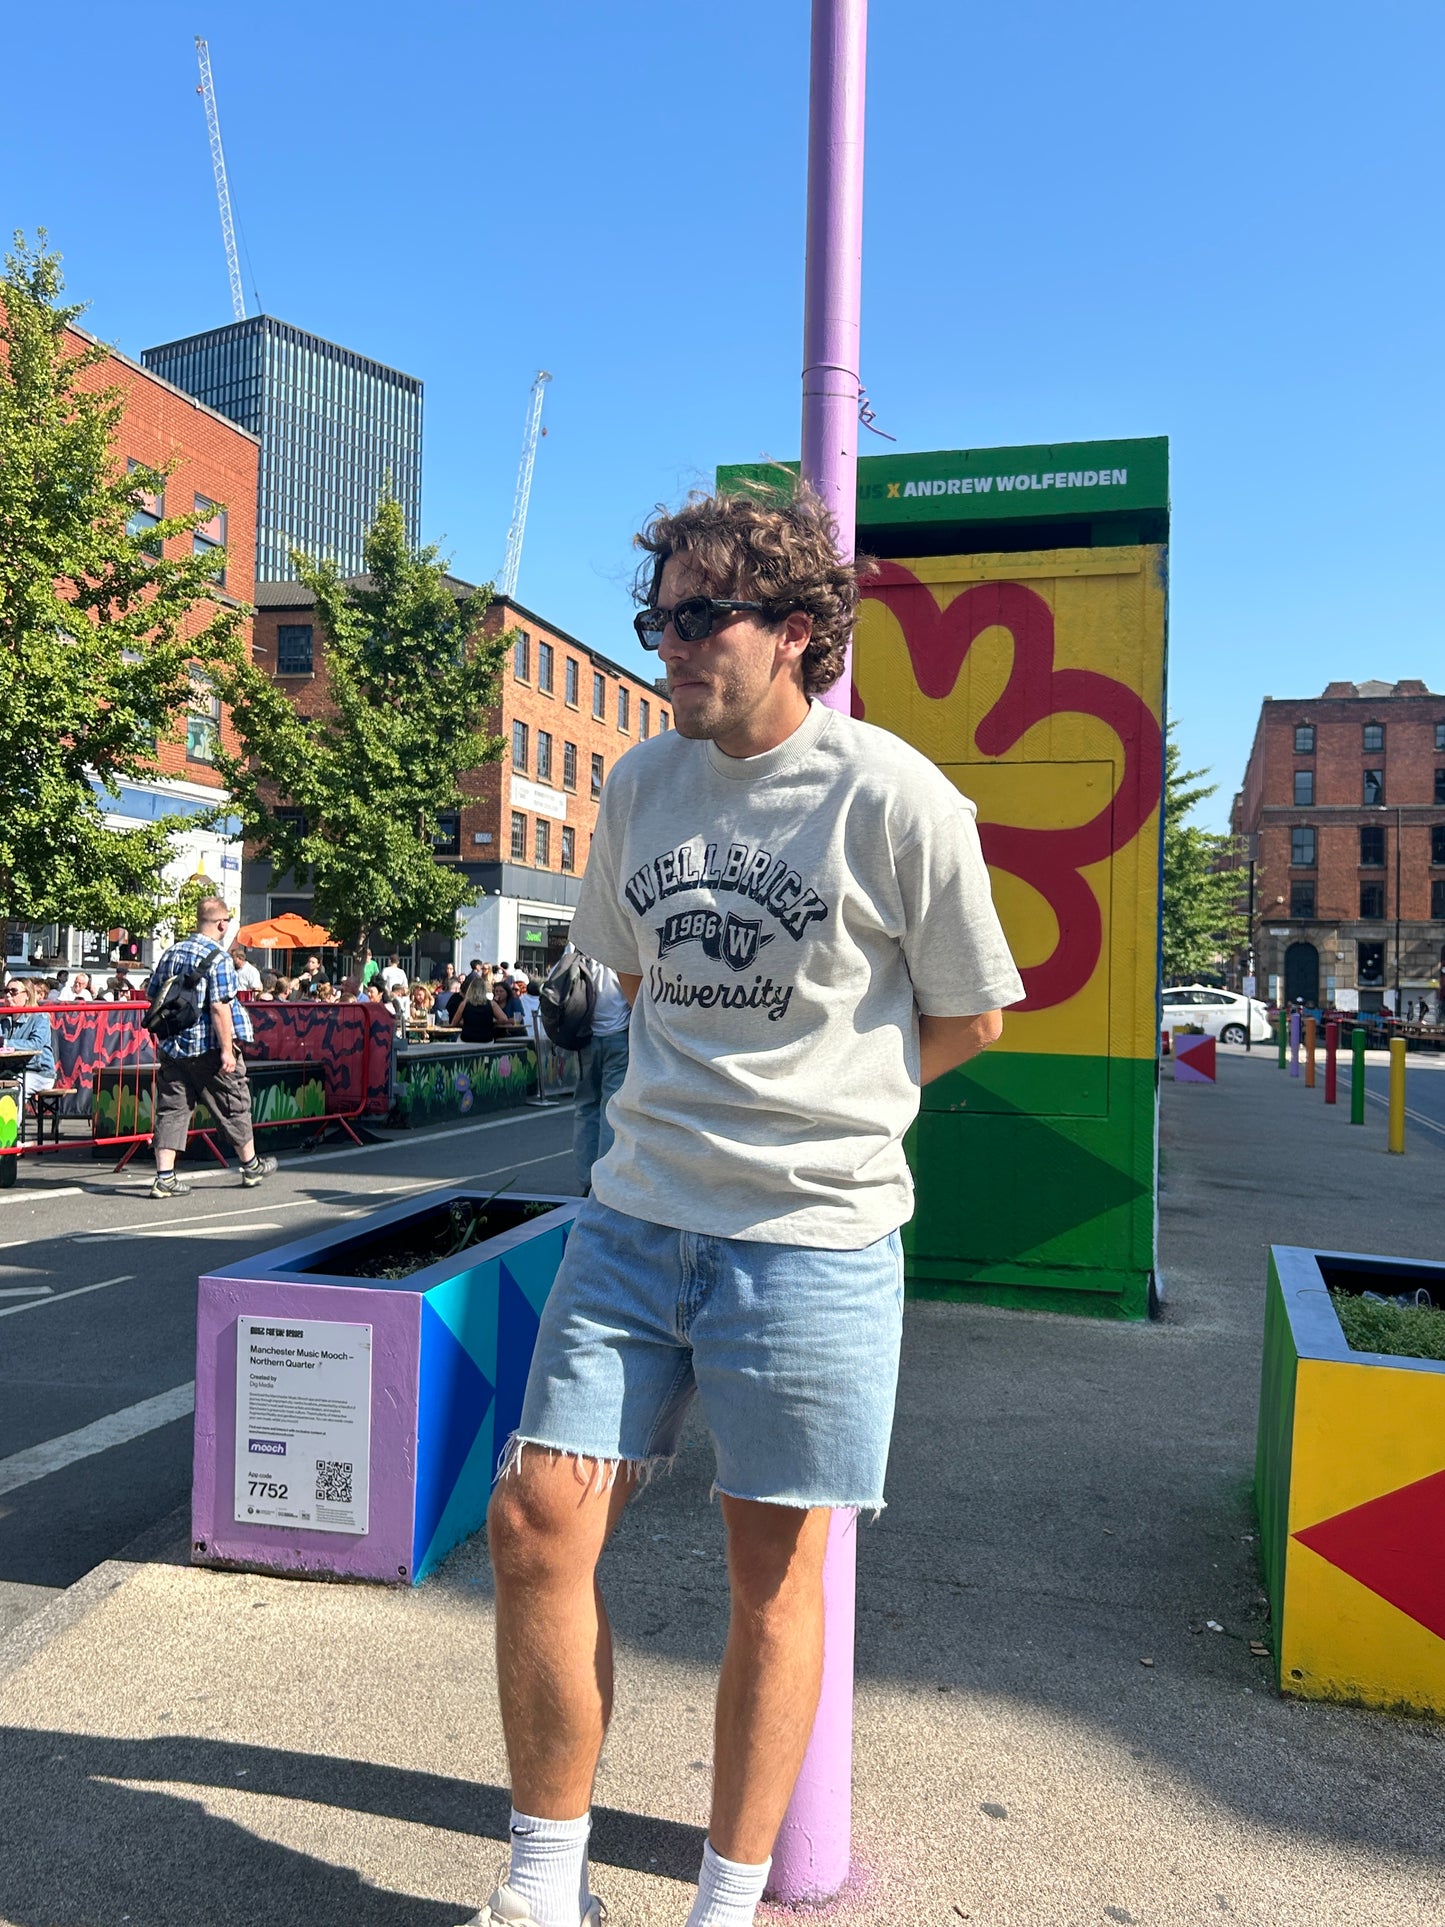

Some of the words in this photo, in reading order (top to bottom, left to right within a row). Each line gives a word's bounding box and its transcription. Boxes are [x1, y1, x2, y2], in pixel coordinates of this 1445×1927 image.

[886, 482, 901, 498] X
[903, 477, 993, 497] ANDREW
[996, 468, 1128, 492] WOLFENDEN
[625, 843, 829, 942] WELLBRICK
[669, 913, 719, 941] 1986
[728, 924, 758, 960] W
[650, 964, 794, 1022] University
[250, 1344, 296, 1357] Manchester
[297, 1348, 320, 1358] Music
[321, 1350, 348, 1360] Mooch
[250, 1356, 285, 1367] Northern
[286, 1359, 316, 1369] Quarter
[249, 1373, 270, 1381] Created
[251, 1443, 284, 1453] mooch
[248, 1471, 259, 1479] App
[248, 1481, 288, 1499] 7752
